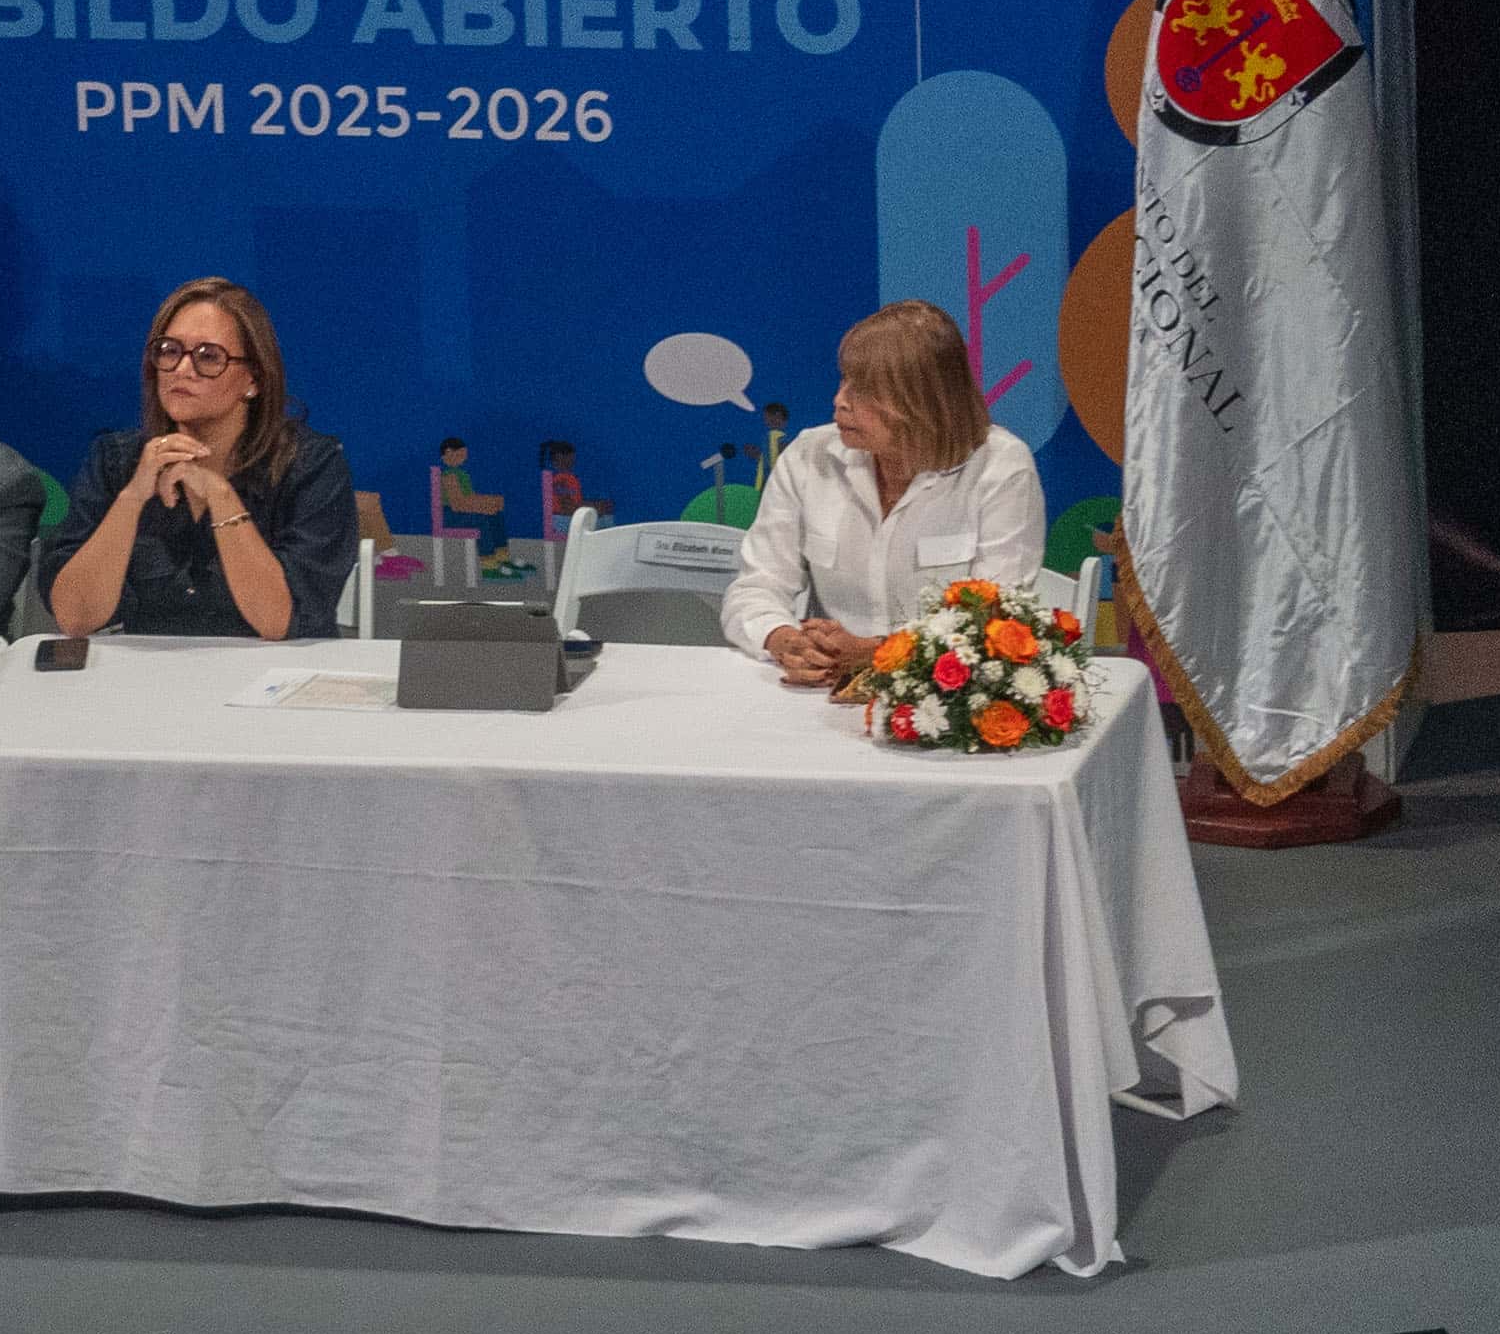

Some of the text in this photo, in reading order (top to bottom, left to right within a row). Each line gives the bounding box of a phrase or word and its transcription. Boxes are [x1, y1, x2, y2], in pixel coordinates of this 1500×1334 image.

[76, 81, 613, 143] PPM 2025-2026
[1171, 248, 1220, 324] DEL
